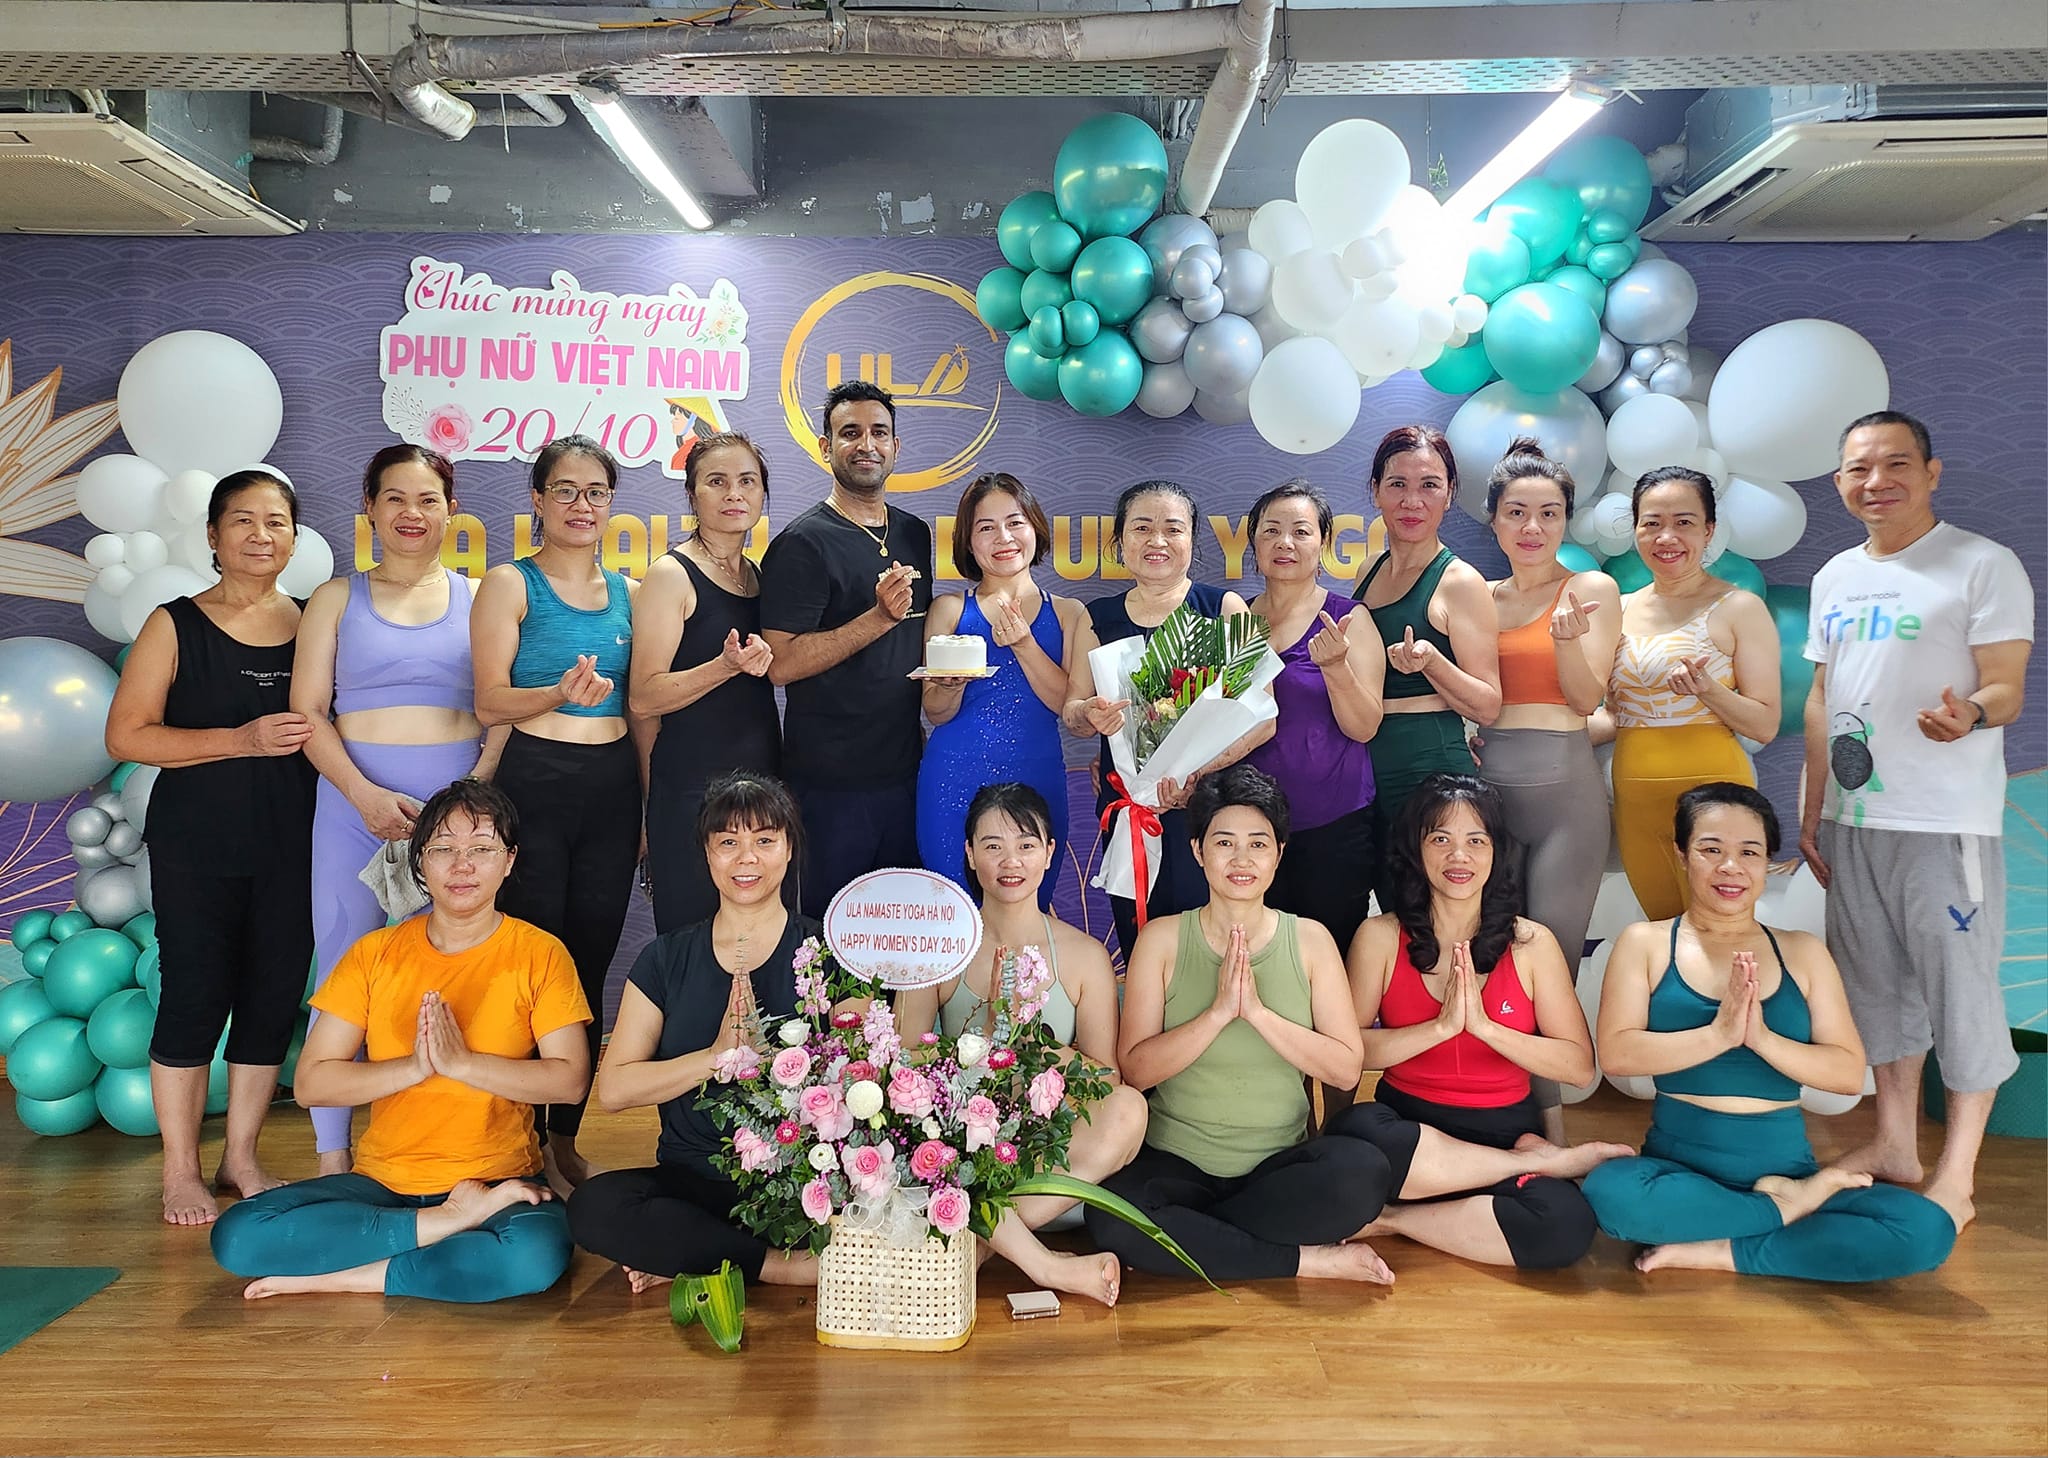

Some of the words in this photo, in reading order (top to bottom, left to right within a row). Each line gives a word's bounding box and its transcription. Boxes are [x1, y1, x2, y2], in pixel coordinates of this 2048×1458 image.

[414, 269, 500, 312] Chúc
[511, 278, 612, 334] mừng
[621, 290, 707, 338] ngày
[388, 333, 467, 388] PHỤ
[480, 332, 538, 382] NỮ
[551, 335, 635, 395] VIỆT
[647, 345, 741, 392] NAM
[826, 347, 969, 396] ULA
[1823, 605, 1922, 644] Tribe
[846, 902, 861, 918] ULA
[863, 902, 901, 919] NAMASTE
[903, 903, 926, 921] YOGA
[927, 902, 938, 921] HÀ
[941, 902, 955, 925] NỘI
[840, 933, 870, 950] HAPPY
[873, 933, 917, 953] WOMEN'S
[920, 936, 939, 954] DAY
[941, 937, 965, 955] 20-10
